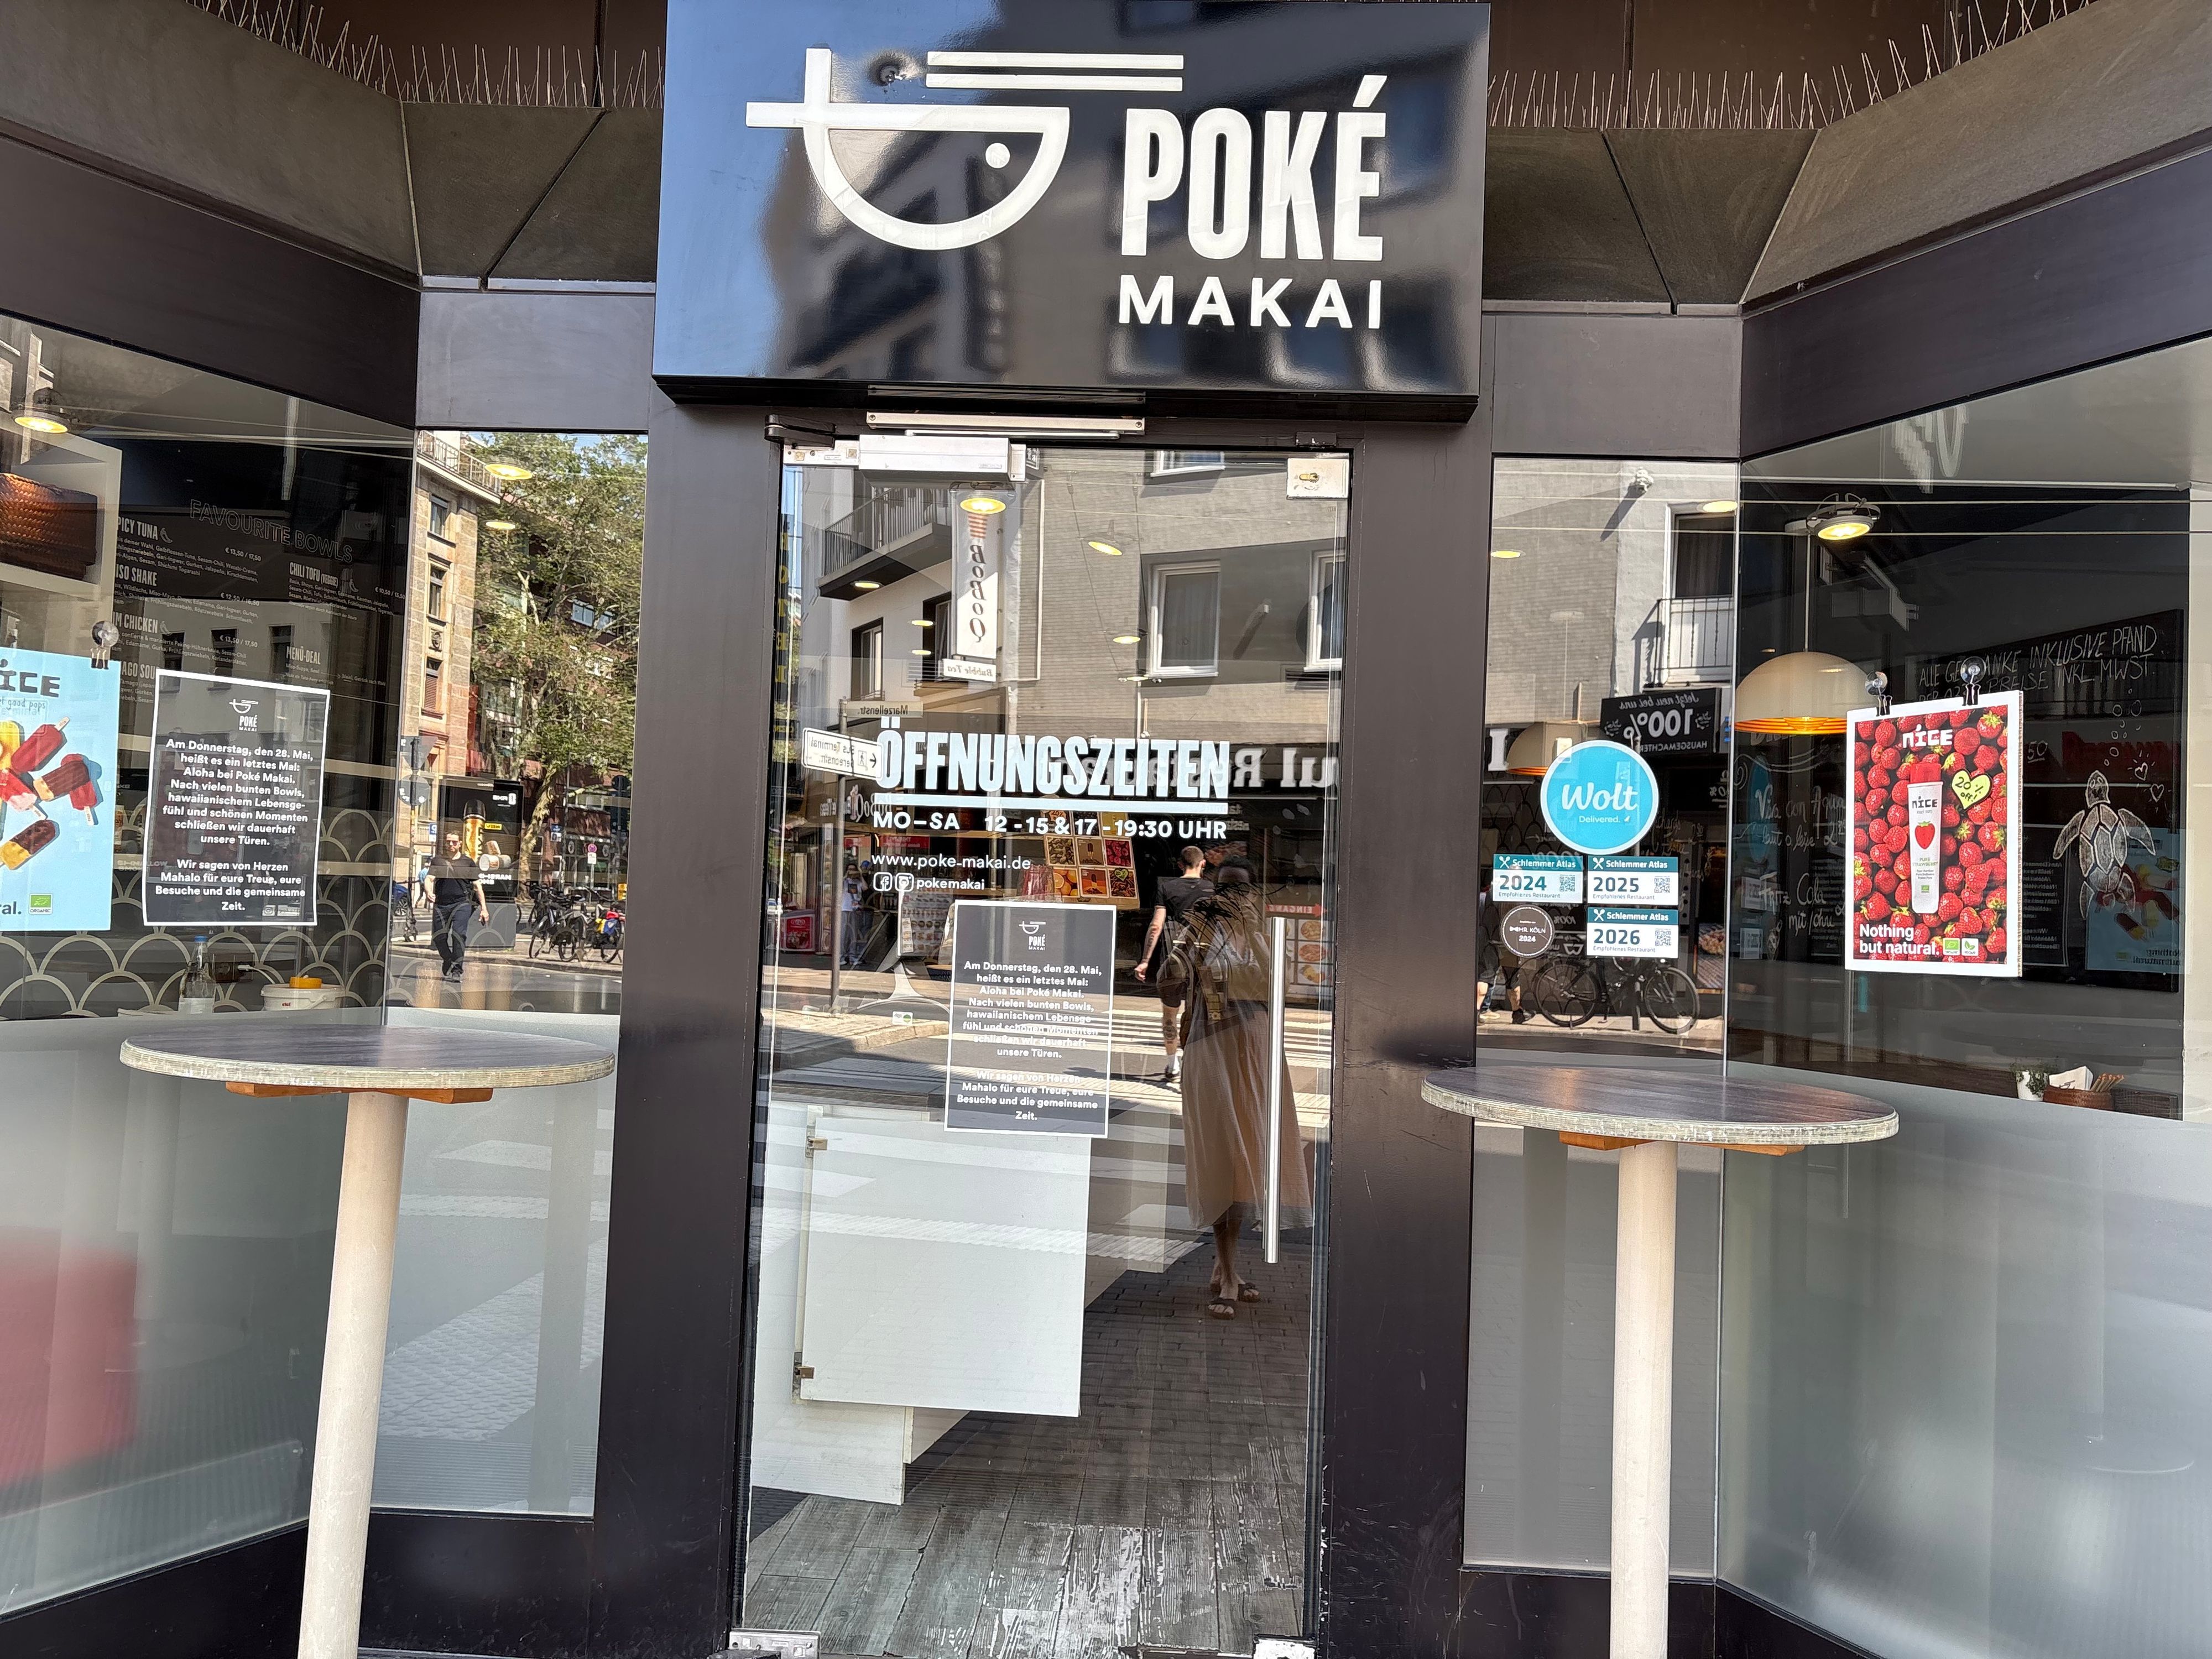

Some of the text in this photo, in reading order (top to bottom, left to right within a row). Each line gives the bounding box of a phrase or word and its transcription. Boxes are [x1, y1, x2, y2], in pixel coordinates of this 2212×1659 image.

[1121, 75, 1388, 261] POKÉ
[1119, 274, 1382, 330] MAKAI
[118, 517, 158, 540] PICY TUNA
[191, 499, 352, 563] FAVOURITE BOWLS
[230, 549, 261, 562] 13,50 17,50
[116, 564, 157, 586] ISO SHAKE
[289, 562, 304, 577] CHILI
[306, 566, 320, 582] TOFU
[124, 613, 158, 633] CHICKEN
[286, 646, 321, 665] MENÜ-DEAL
[1919, 664, 1940, 687] ALLE
[2030, 632, 2107, 668] INKLUSIVE
[2112, 625, 2157, 655] PFAND
[1988, 654, 2155, 692] PREISE INKL. MWST.
[8, 697, 25, 710] good
[29, 700, 45, 712] pops
[239, 715, 258, 728] POKÉ
[166, 739, 313, 761] Am Donnerstag, den 28. Mai,
[874, 716, 1230, 799] ÖFFNUNGSZEITEN
[180, 753, 208, 765] heißt
[225, 757, 240, 766] ein
[243, 758, 276, 770] letztes
[279, 761, 300, 771] Mal:
[183, 767, 295, 784] Aloha bei Poké Makai.
[170, 779, 305, 799] Nach vielen bunten Bowls,
[1954, 777, 1971, 790] 20
[168, 792, 305, 810] hawaiianischem Lebensge-
[1561, 782, 1639, 812] Wolt
[1961, 792, 1978, 802] off!
[163, 805, 308, 822] fühl und schönen Momenten
[1579, 815, 1620, 823] Delivered.
[175, 820, 295, 834] schließen wir dauerhaft
[984, 816, 1006, 833] 12
[1026, 816, 1048, 835] 15
[1055, 816, 1071, 836] &
[1076, 818, 1097, 836] 17
[1117, 819, 1172, 839] 19:30
[1178, 821, 1227, 839] UHR
[200, 835, 270, 846] unsere Türen.
[177, 859, 197, 869] Wir
[199, 861, 229, 872] sagen
[253, 861, 288, 872] Herzen
[871, 852, 1031, 870] www.poke-makai.de
[1512, 859, 1554, 868] Schlemmer
[1556, 859, 1576, 869] Atlas
[1606, 860, 1668, 869] Schlemmer Atlas
[160, 872, 200, 882] Mahalo
[203, 872, 219, 883] für
[221, 875, 244, 883] eure
[246, 874, 277, 885] Treue,
[916, 876, 985, 891] pokemakai
[1499, 874, 1547, 891] 2024
[1593, 877, 1639, 893] 2025
[155, 885, 305, 898] Besuche und die gemeinsame
[221, 901, 246, 911] Zeit.
[1606, 912, 1669, 921] Schlemmer Atlas
[1594, 928, 1640, 945] 2026
[1860, 924, 1914, 941] Nothing
[1029, 934, 1046, 947] POKÉ
[1860, 940, 1940, 955] but natural.
[964, 961, 1102, 977] Am Donnerstag, den 28. Mai,
[977, 974, 1001, 983] heißt
[1016, 975, 1031, 984] ein
[1033, 975, 1065, 985] letztes
[1067, 977, 1088, 987] Mal:
[979, 986, 1084, 999] Aloha bei Poké Makai.
[968, 998, 1094, 1013] Nach vielen bunten Bowls,
[966, 1009, 1044, 1021] hawaiianischem
[997, 1048, 1062, 1058] unsere Türen.
[962, 1083, 1093, 1098] Mahalo für eure Treue, eure
[957, 1095, 1098, 1109] Besuche und die gemeinsame
[1015, 1110, 1038, 1121] Zeit.
